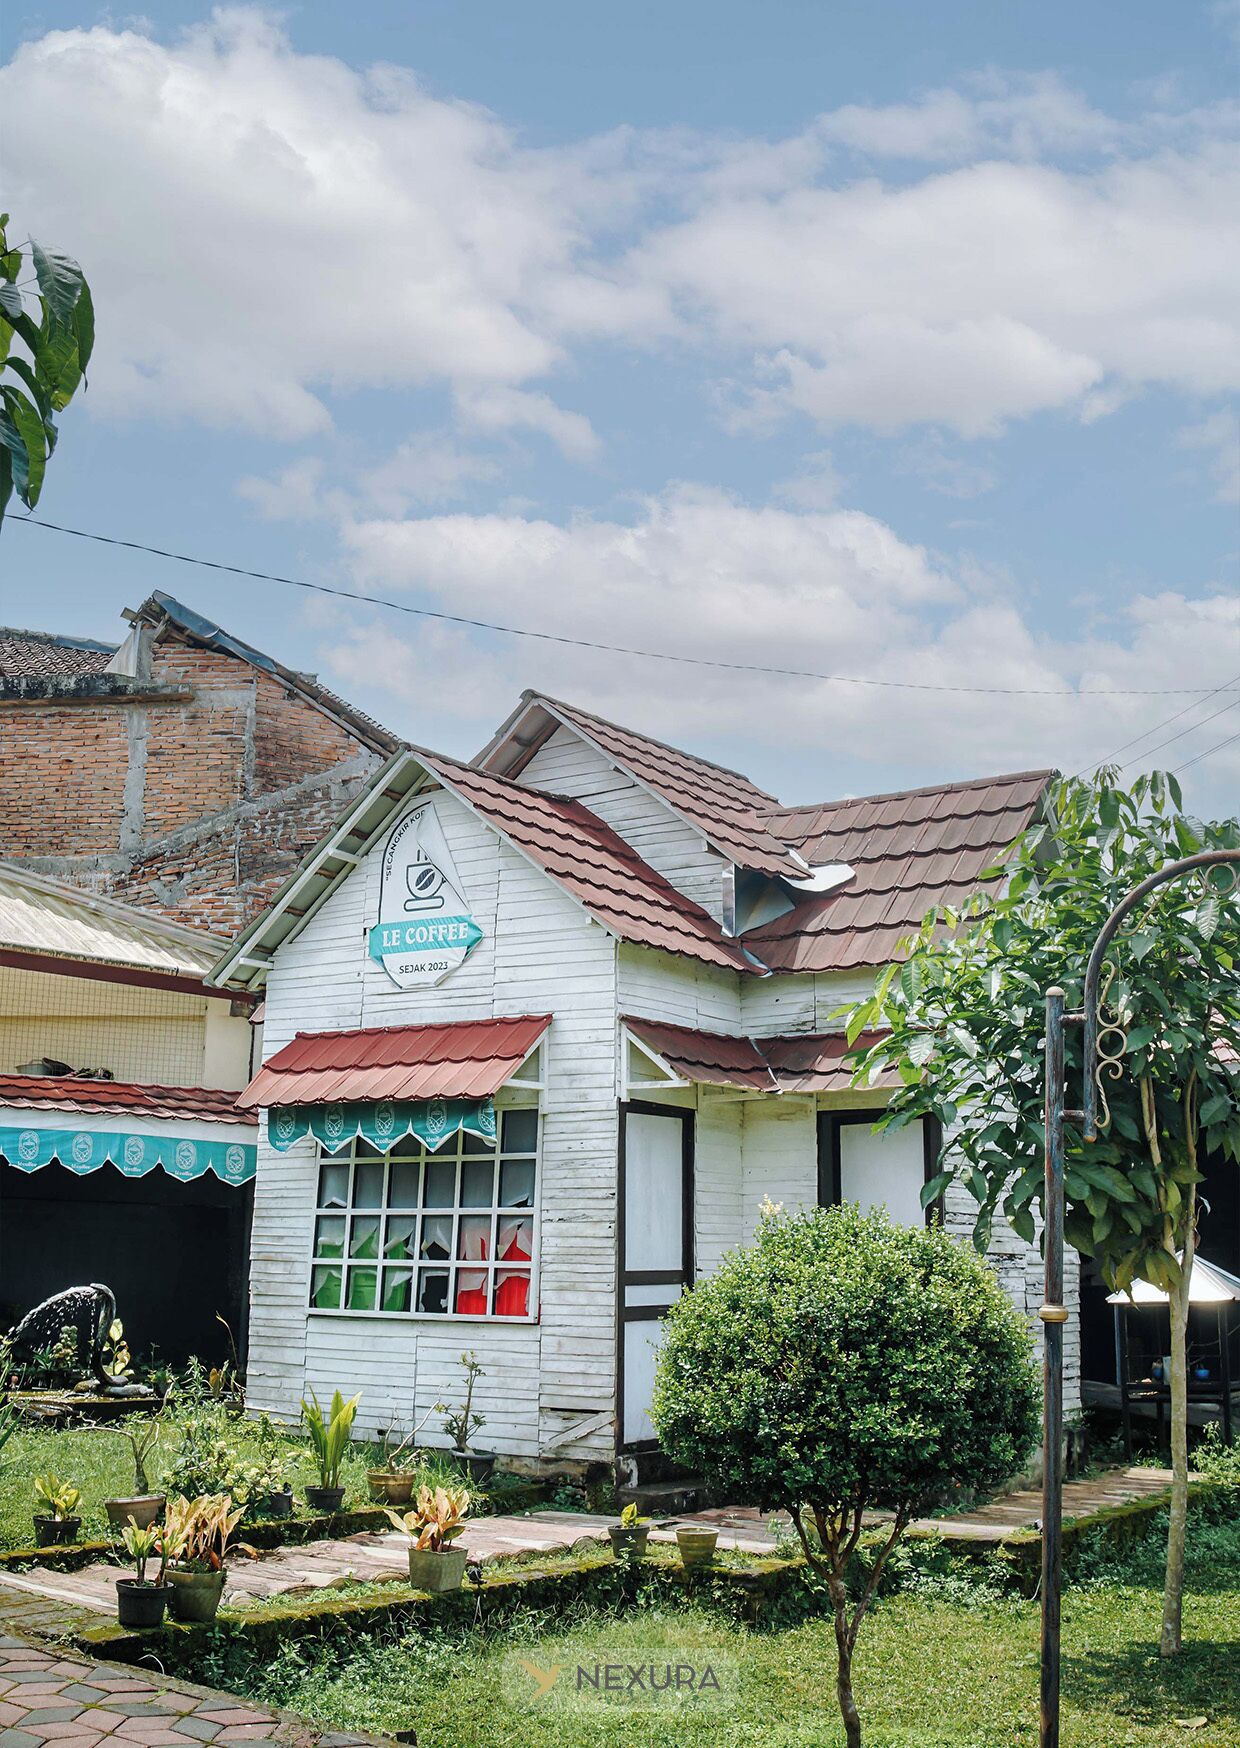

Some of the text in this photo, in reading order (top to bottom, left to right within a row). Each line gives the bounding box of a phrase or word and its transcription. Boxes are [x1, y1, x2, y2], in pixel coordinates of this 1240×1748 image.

[382, 922, 469, 948] LE COFFEE
[399, 961, 448, 975] SEJAK 2023
